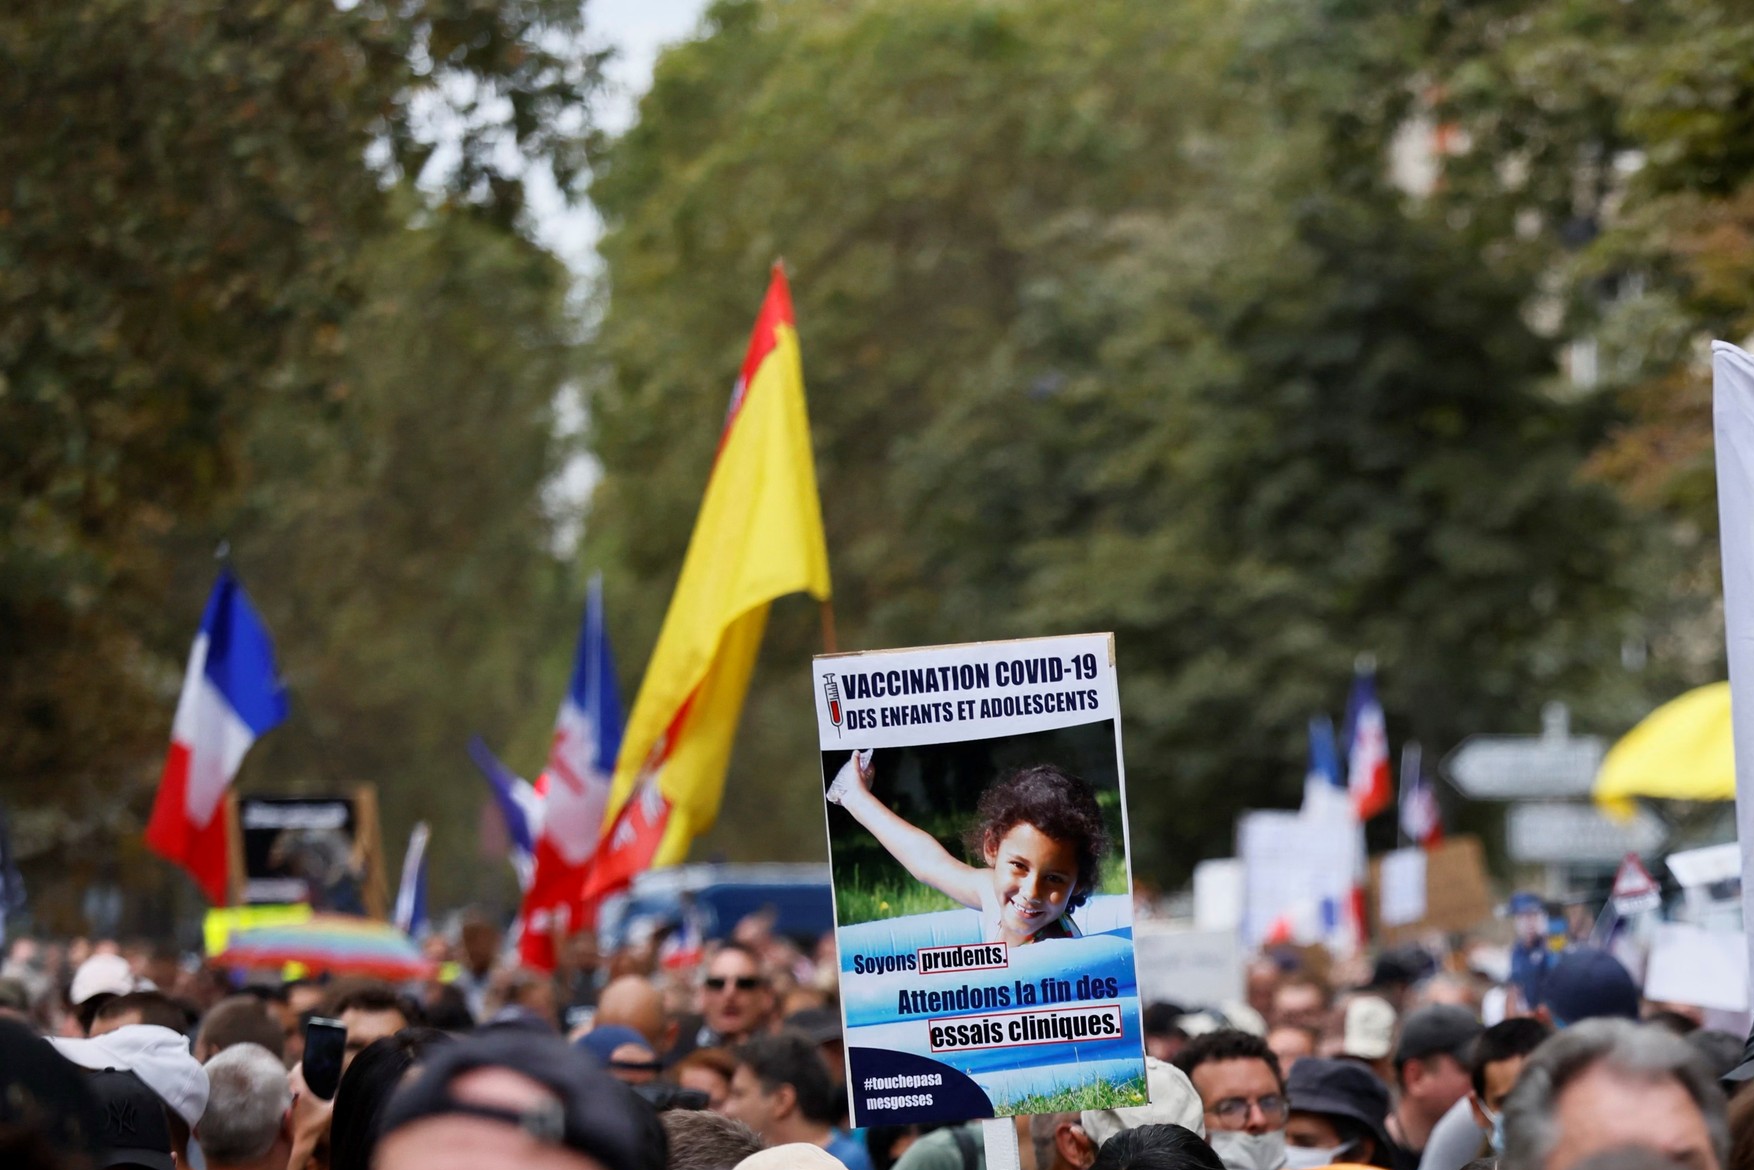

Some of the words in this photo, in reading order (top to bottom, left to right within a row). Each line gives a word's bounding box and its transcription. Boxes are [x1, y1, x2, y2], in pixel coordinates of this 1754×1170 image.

[841, 661, 990, 700] VACCINATION
[995, 652, 1098, 688] COVID-19
[845, 707, 878, 731] DES
[880, 701, 954, 728] ENFANTS
[957, 699, 976, 721] ET
[980, 689, 1100, 719] ADOLESCENTS
[853, 953, 917, 975] Soyons
[921, 946, 1008, 972] prudents.
[898, 984, 1011, 1015] Attendons
[1014, 980, 1037, 1006] la
[1040, 976, 1073, 1004] fin
[1075, 974, 1120, 1000] des
[931, 1019, 1004, 1049] essais
[1008, 1012, 1122, 1043] cliniques.
[863, 1073, 943, 1091] #touchepasa
[866, 1093, 934, 1110] mesgosses
